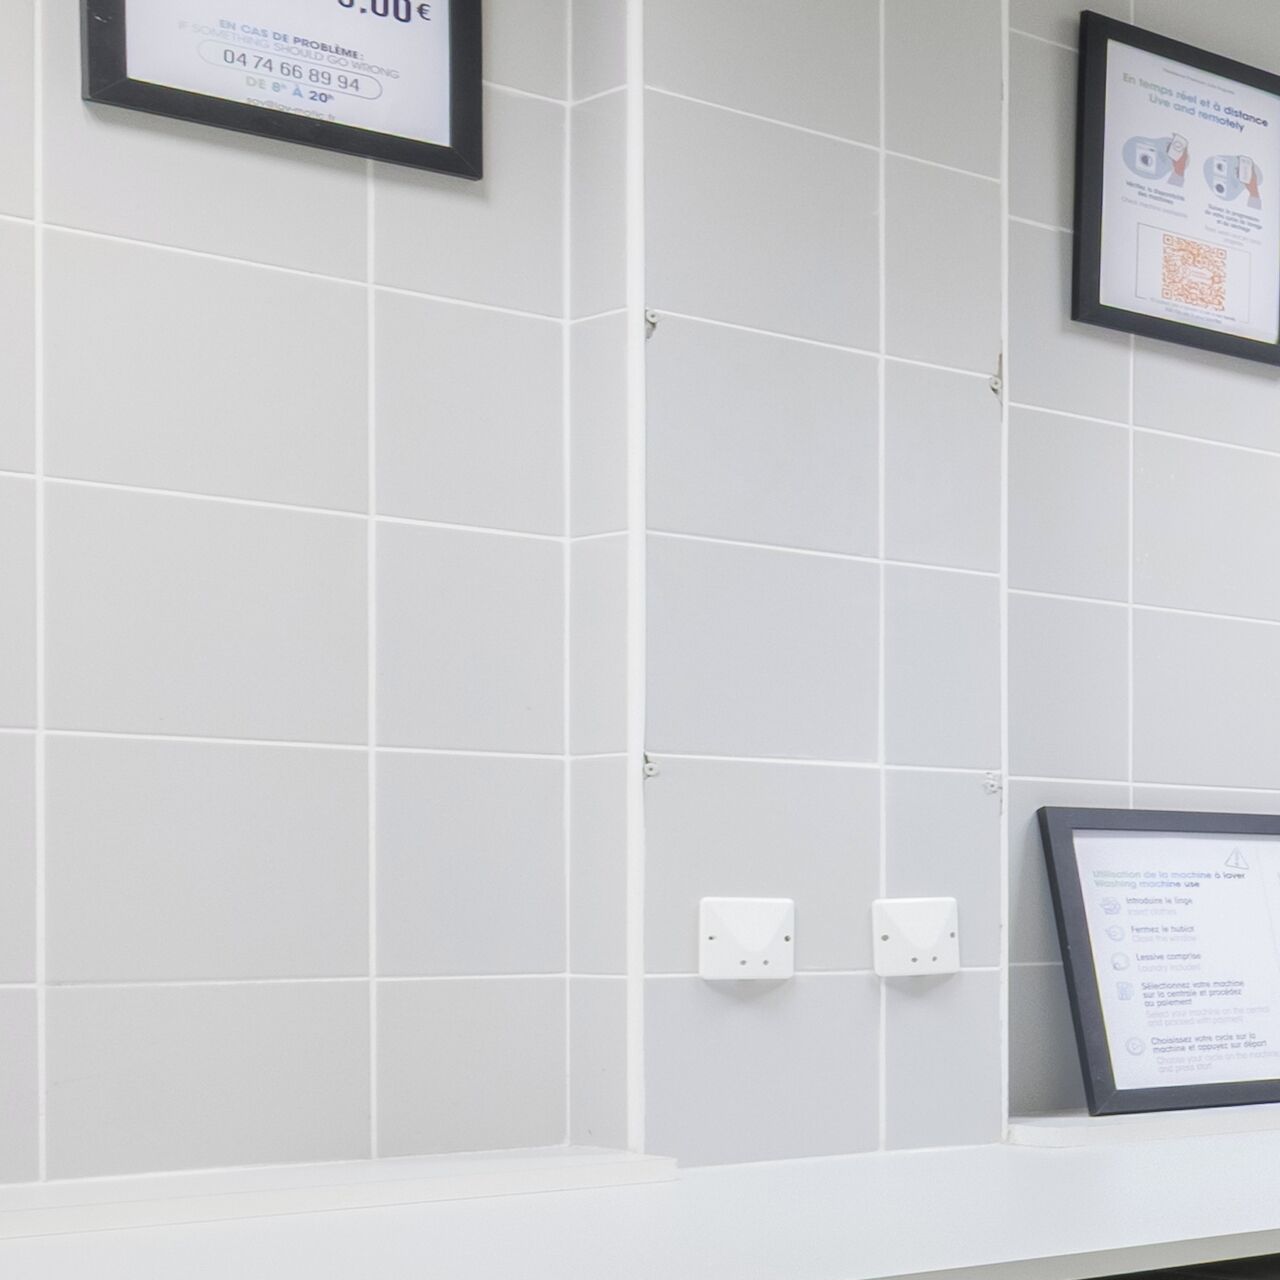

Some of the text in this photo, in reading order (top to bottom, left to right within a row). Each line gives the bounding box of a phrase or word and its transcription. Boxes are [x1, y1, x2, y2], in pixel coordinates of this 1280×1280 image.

[219, 19, 236, 32] EN
[241, 24, 268, 38] CAS
[272, 31, 289, 43] DE
[223, 49, 360, 92] 04 74 66 89 94
[1198, 111, 1245, 132] remotely
[1224, 105, 1268, 128] distance
